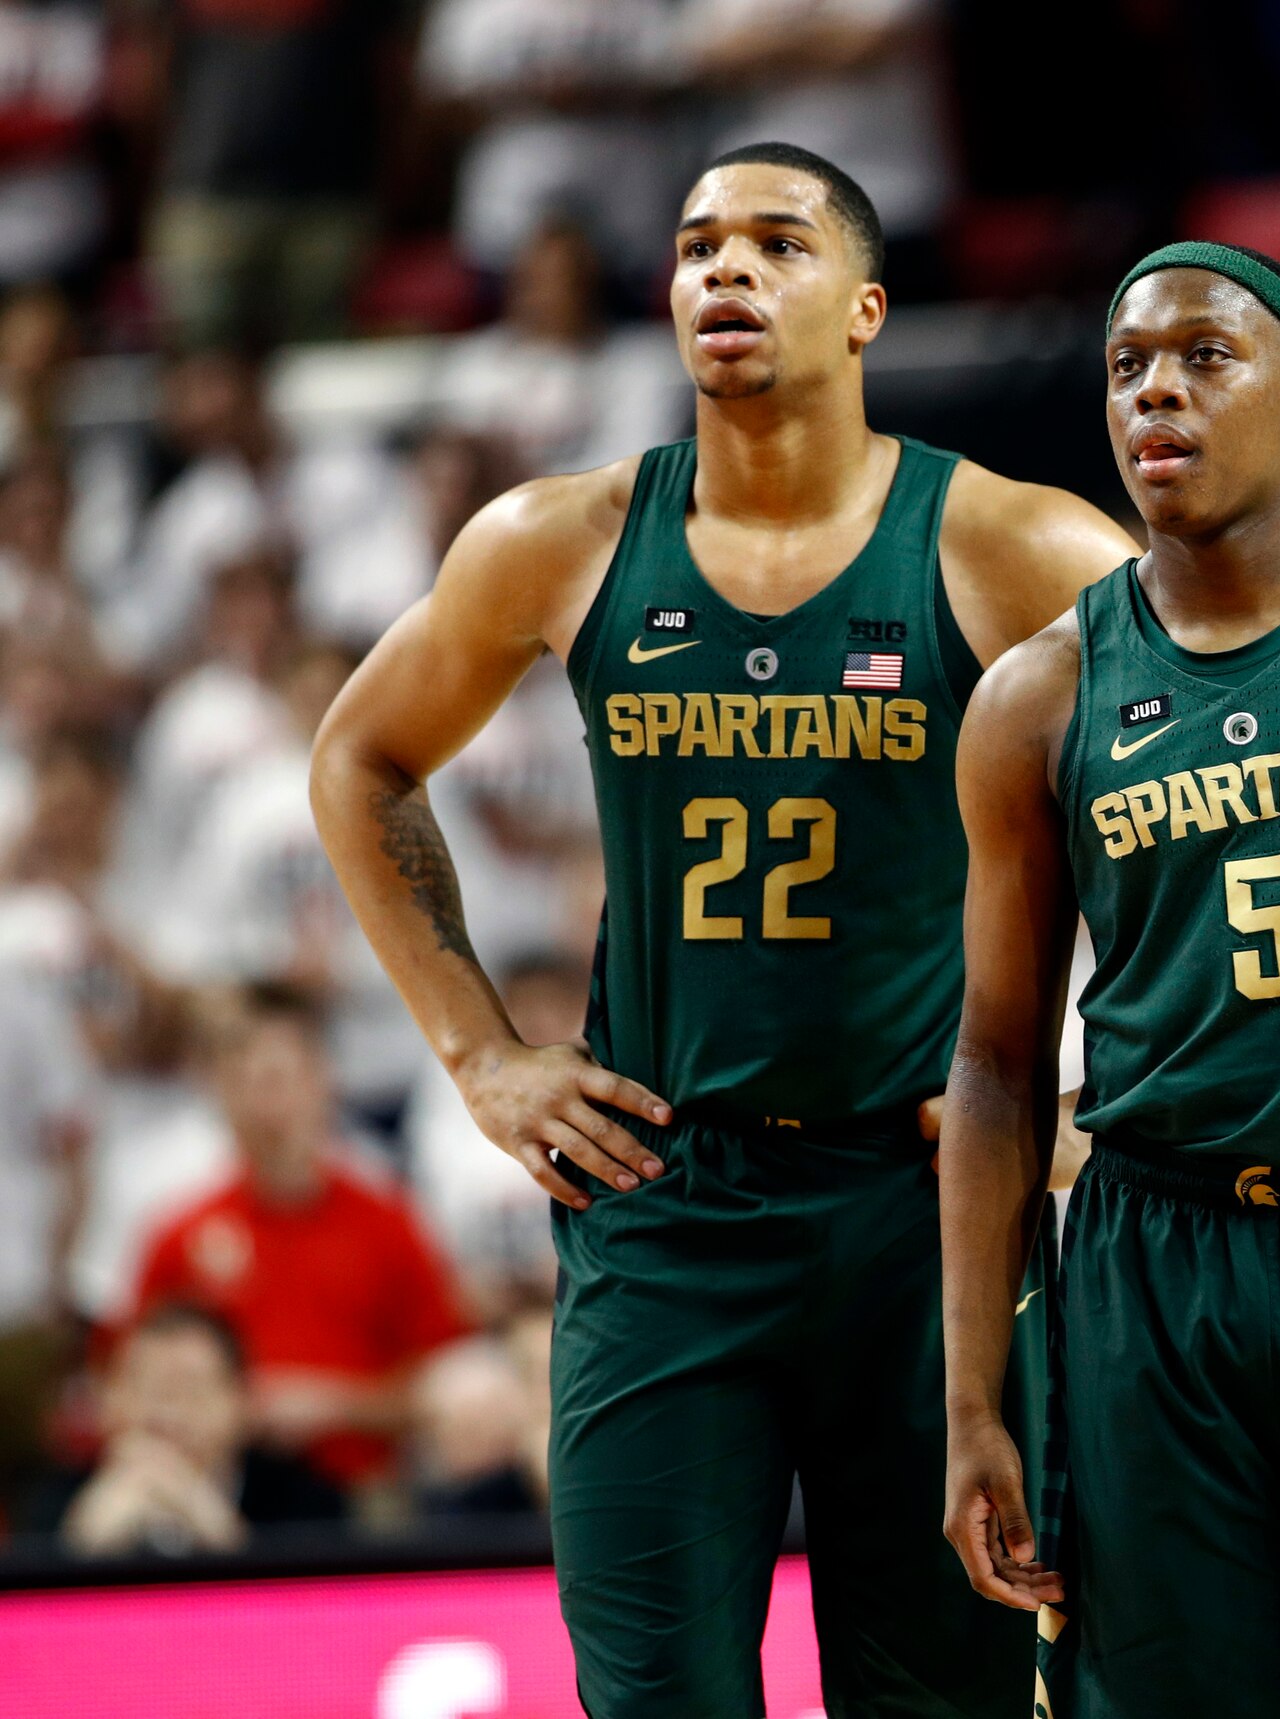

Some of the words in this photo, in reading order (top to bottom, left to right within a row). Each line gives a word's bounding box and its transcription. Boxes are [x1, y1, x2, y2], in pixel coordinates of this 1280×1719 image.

[653, 611, 685, 628] JUD
[606, 693, 927, 761] SPARTANS
[1129, 700, 1161, 721] JUD
[682, 797, 837, 939] 22
